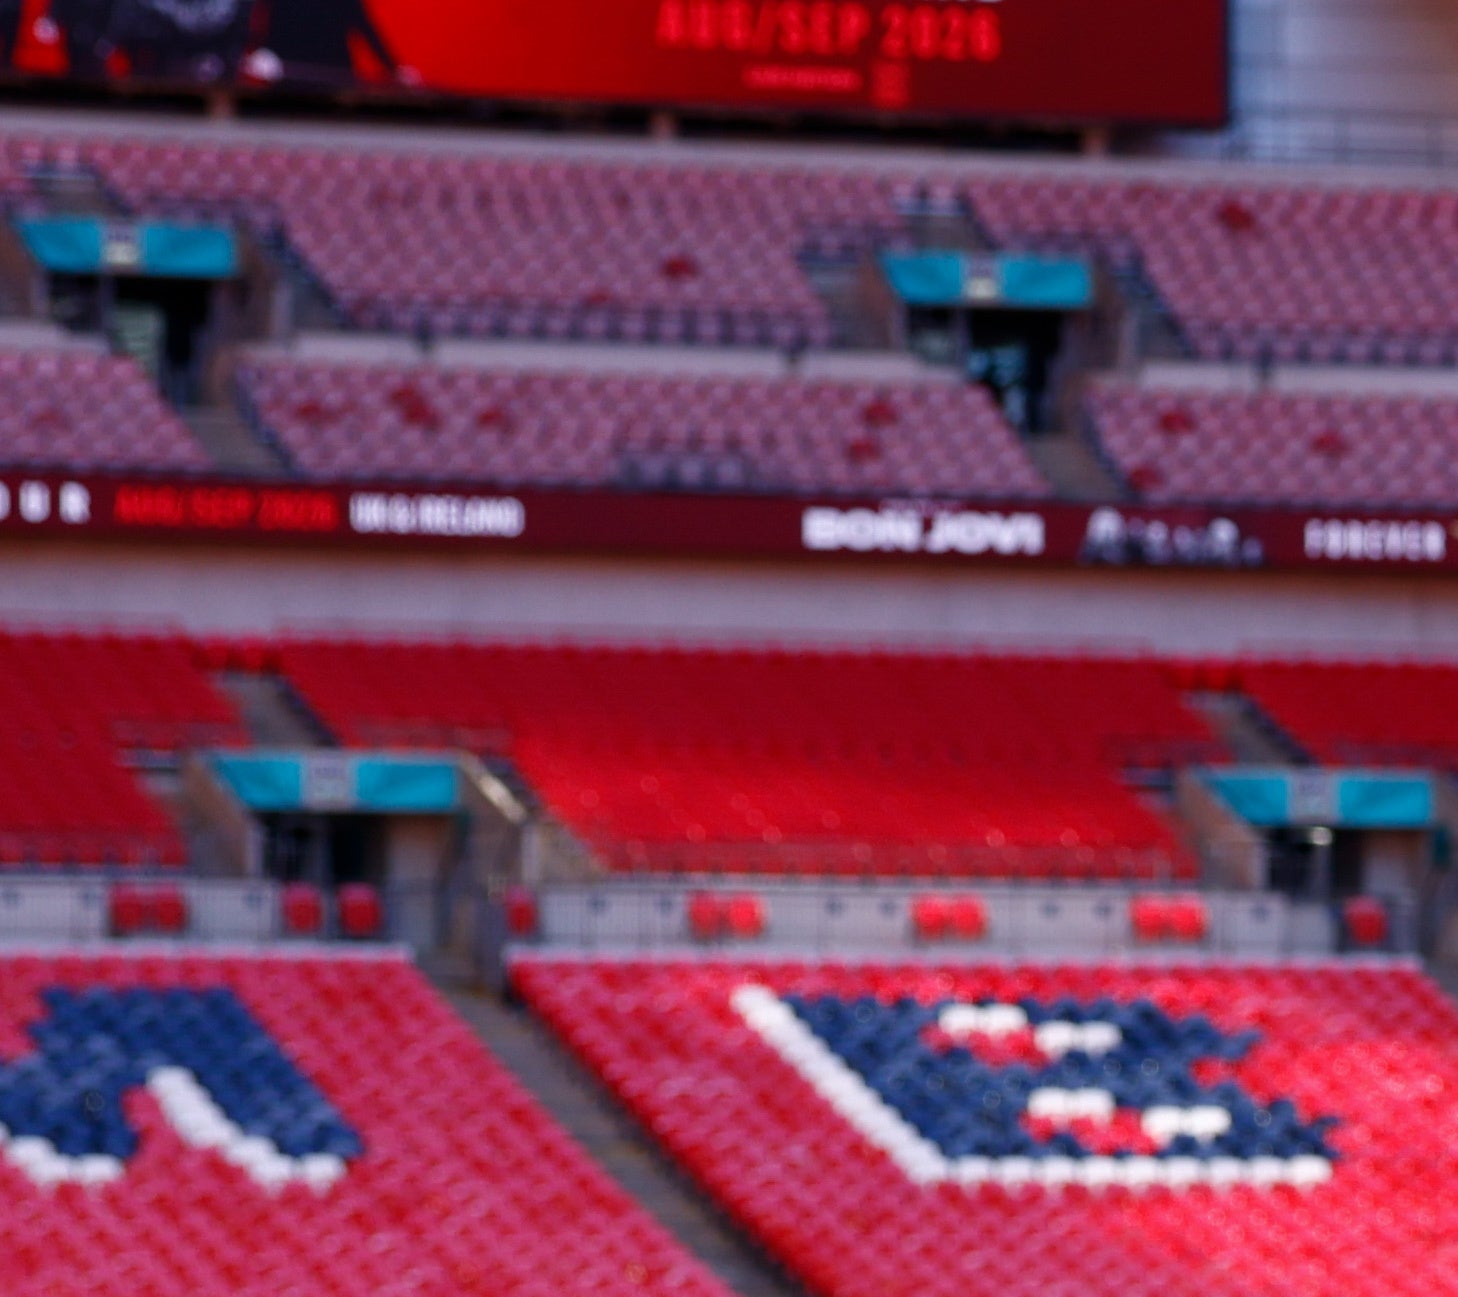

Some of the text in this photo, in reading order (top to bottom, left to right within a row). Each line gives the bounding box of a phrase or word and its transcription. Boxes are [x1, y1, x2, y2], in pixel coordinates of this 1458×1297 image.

[655, 2, 1000, 62] AUG/SEP 2026
[802, 506, 1045, 555] BON JOVI
[1304, 518, 1446, 562] FOREVER
